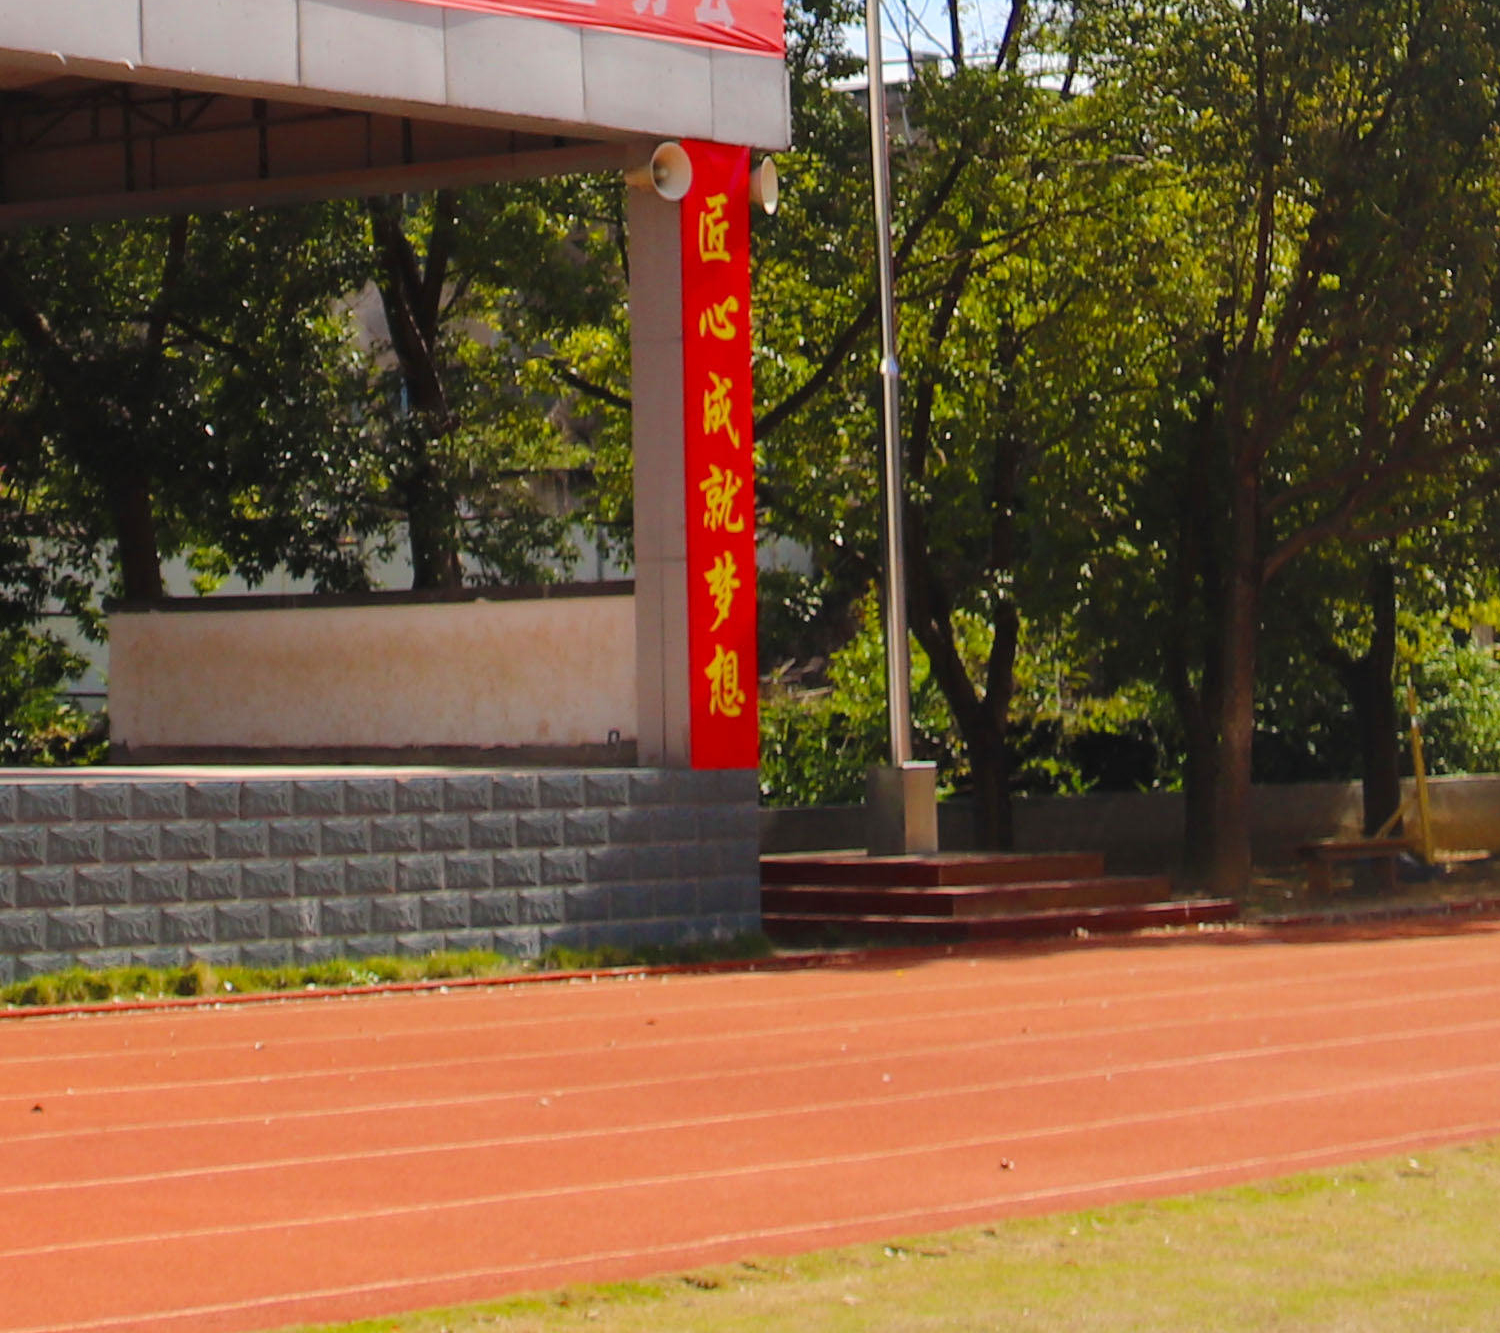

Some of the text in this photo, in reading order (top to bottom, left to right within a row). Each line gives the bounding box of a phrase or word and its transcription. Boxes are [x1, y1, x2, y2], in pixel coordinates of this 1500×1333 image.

[698, 192, 746, 719] 匠心成就梦想
